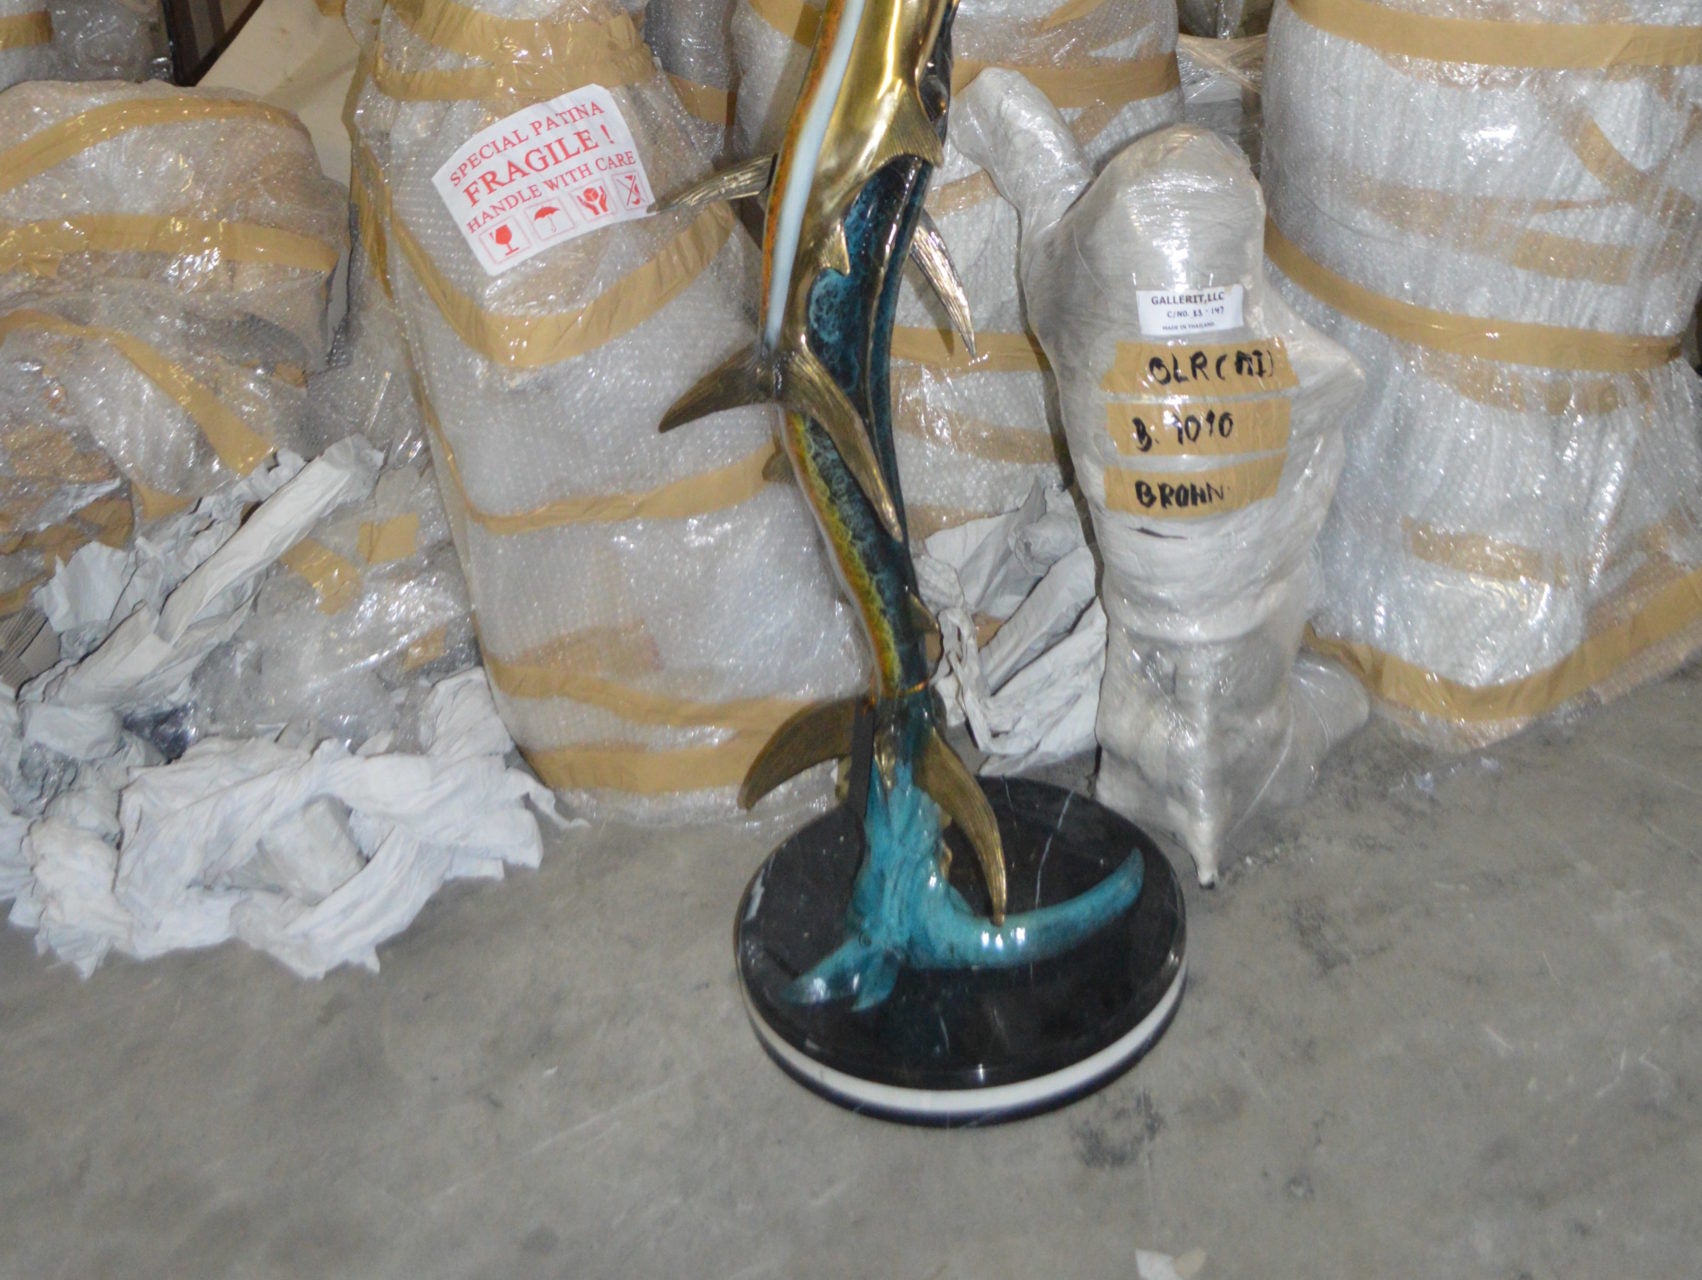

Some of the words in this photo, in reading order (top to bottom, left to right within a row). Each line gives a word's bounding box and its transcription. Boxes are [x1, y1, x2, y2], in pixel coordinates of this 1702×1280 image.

[450, 129, 529, 188] SPECIAL
[529, 101, 605, 137] PATINA
[462, 129, 599, 207] FRAGILE
[466, 184, 542, 234] HANDLE
[543, 163, 592, 192] WITH
[595, 151, 637, 173] CARE
